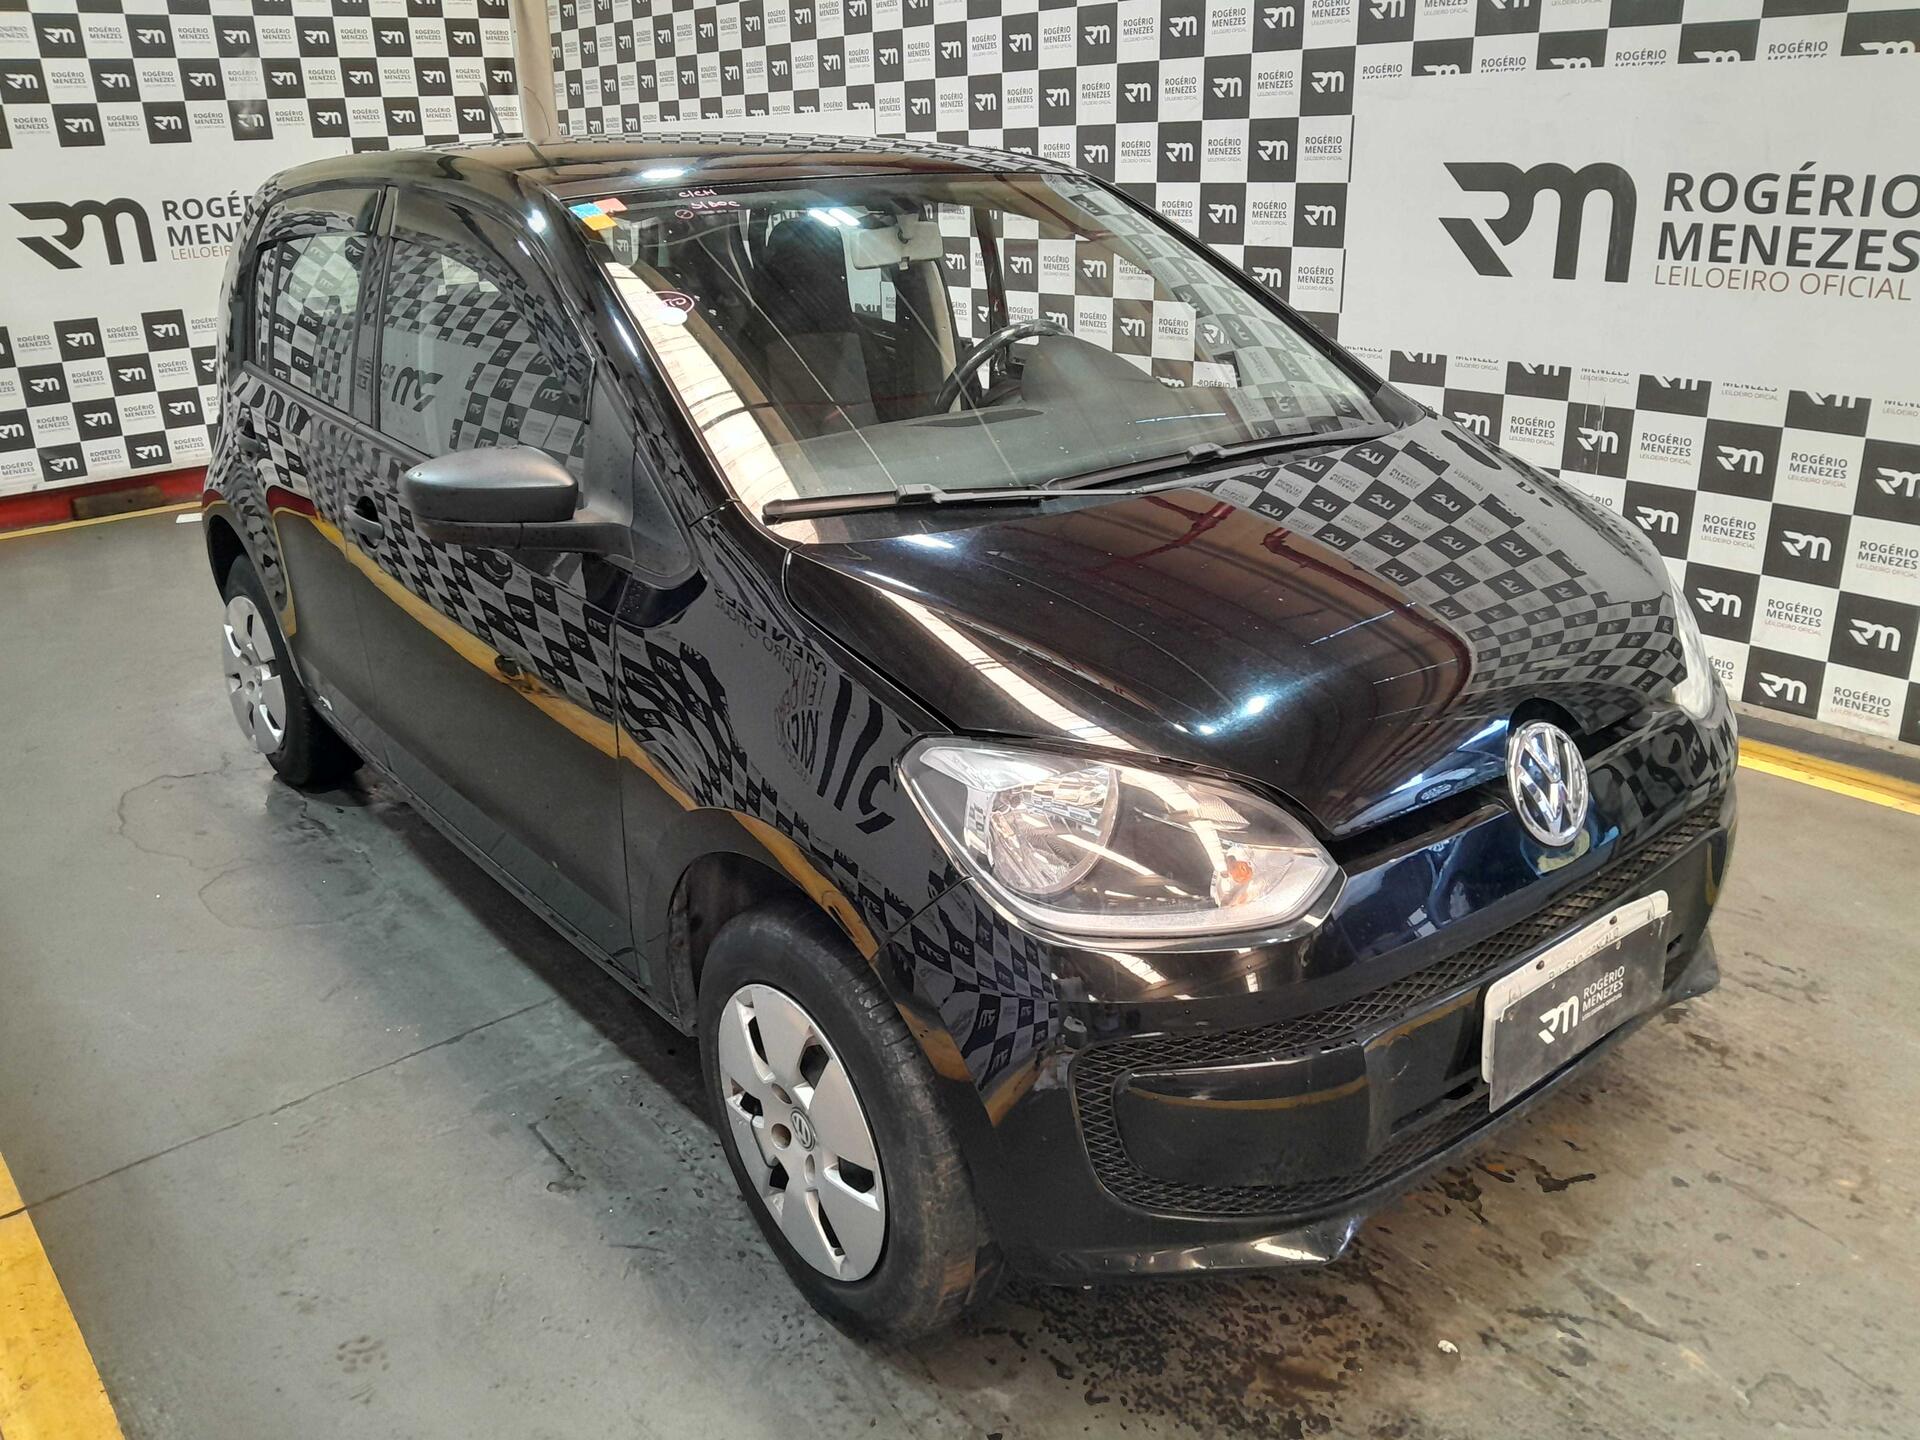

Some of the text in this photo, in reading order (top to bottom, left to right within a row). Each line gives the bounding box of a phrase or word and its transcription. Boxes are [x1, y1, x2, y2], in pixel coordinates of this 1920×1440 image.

[1615, 49, 1667, 61] ROGÉRIO
[1768, 40, 1828, 54] ROGÉRIO
[1362, 63, 1403, 75] ROGÉRIO
[1480, 55, 1527, 68] ROGÉRIO
[1305, 135, 1342, 145] ROGÉRIO
[1305, 145, 1342, 154] MENEZES
[1663, 161, 1920, 219] ROGÉRIO
[162, 190, 252, 221] ROGÉ
[171, 245, 232, 260] LEILOEI
[1658, 221, 1920, 273] MENEZES
[1655, 265, 1912, 301] LEILOEIRO OFICIAL
[1511, 416, 1555, 429] ROGÉRIO
[1510, 425, 1555, 439] MENEZES
[1642, 432, 1692, 447] ROGÉRIO
[1640, 442, 1691, 457] MENEZES
[1791, 452, 1848, 468] ROGÉRIO
[1789, 462, 1847, 479] MENEZES
[1703, 514, 1756, 531] ROGÉRIO
[1702, 524, 1756, 541] MENEZES
[1859, 540, 1919, 559] ROGÉRIO
[1857, 551, 1918, 570] MENEZES
[1768, 598, 1823, 617] ROGÉRIO
[1766, 608, 1821, 628] MENEZES
[1834, 686, 1891, 707] ROGÉRIO
[1832, 696, 1890, 718] MENEZES
[1583, 965, 1625, 999] ROGÉRIO
[1582, 978, 1624, 1012] MENEZES
